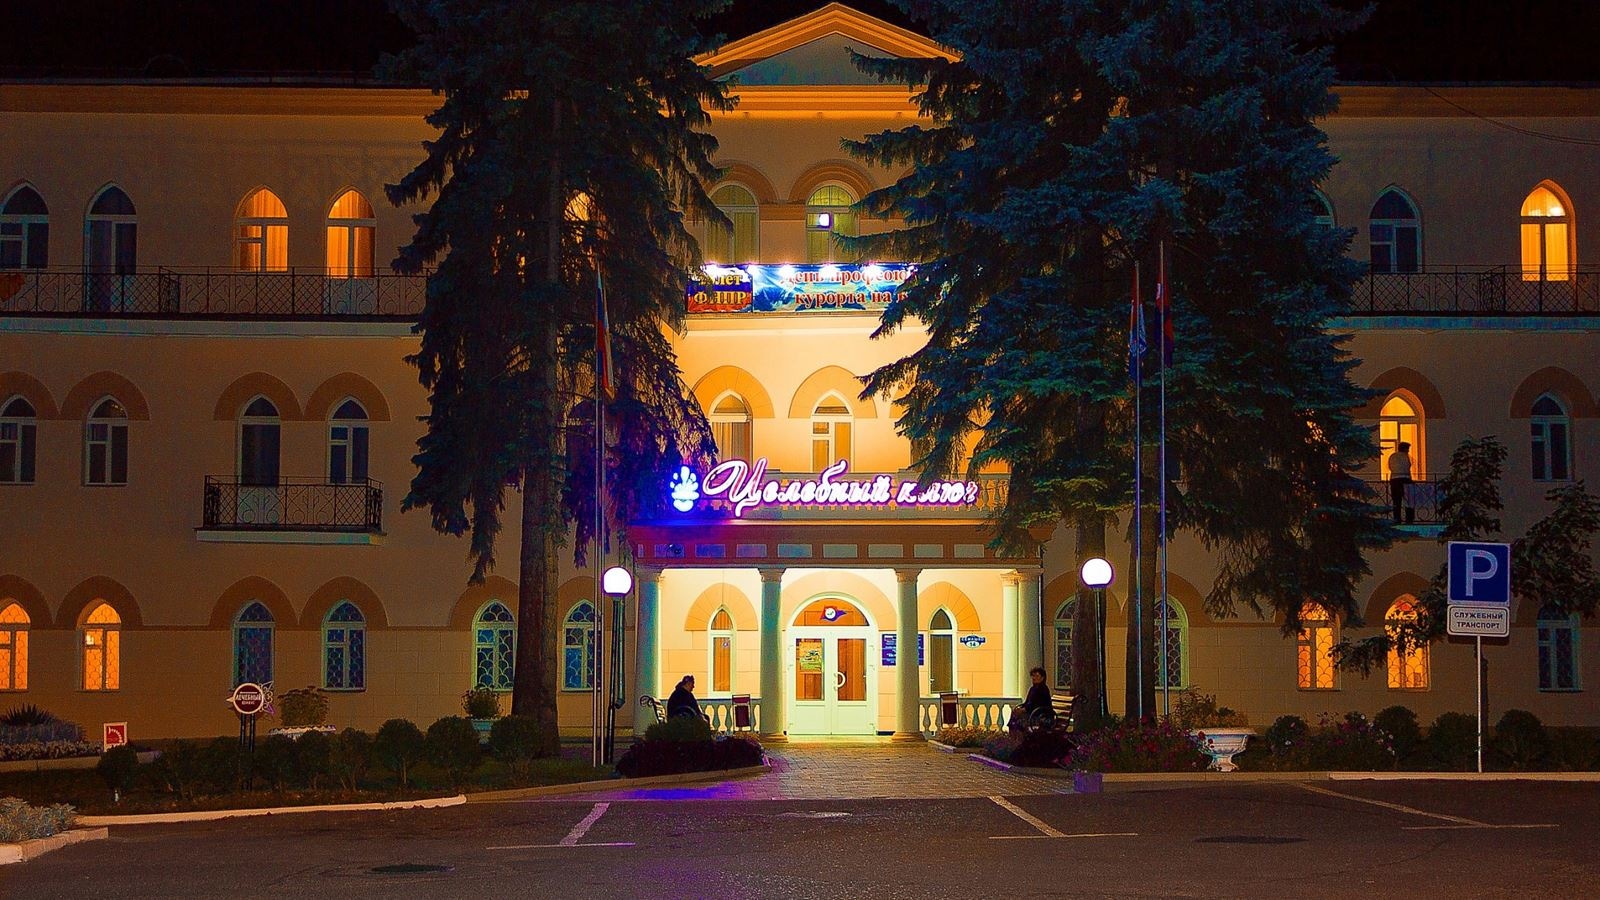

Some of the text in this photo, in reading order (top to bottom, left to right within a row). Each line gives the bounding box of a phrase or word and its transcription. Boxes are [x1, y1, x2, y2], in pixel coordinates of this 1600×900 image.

[795, 292, 866, 308] курорта
[871, 292, 892, 303] на
[702, 457, 892, 518] Целебный
[1456, 621, 1500, 629] ТРАНСПОРТ
